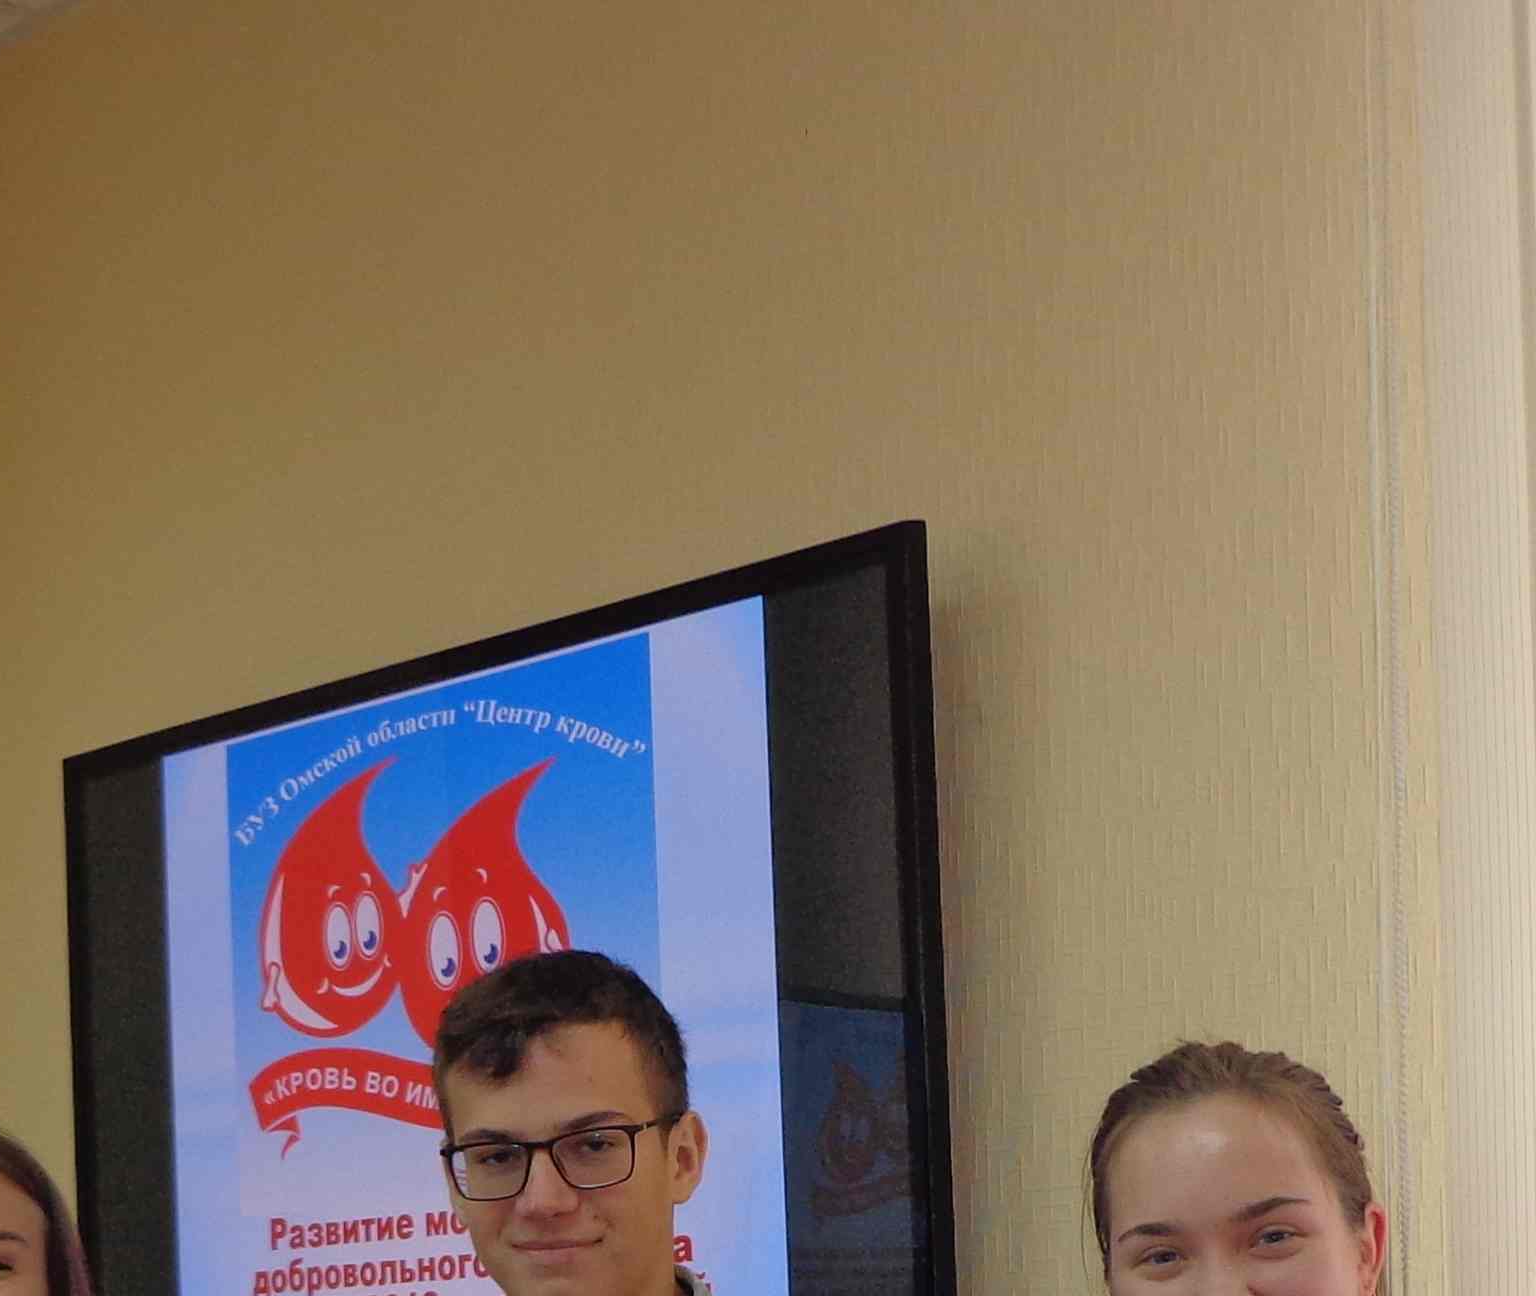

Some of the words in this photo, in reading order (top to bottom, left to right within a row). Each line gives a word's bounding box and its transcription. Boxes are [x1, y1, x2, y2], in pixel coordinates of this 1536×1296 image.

[234, 797, 279, 847] БУЗ
[280, 735, 362, 799] Омской
[367, 708, 456, 748] области
[366, 1071, 399, 1098] ВО
[405, 1081, 441, 1110] ИМ
[270, 1213, 414, 1250] Развитие
